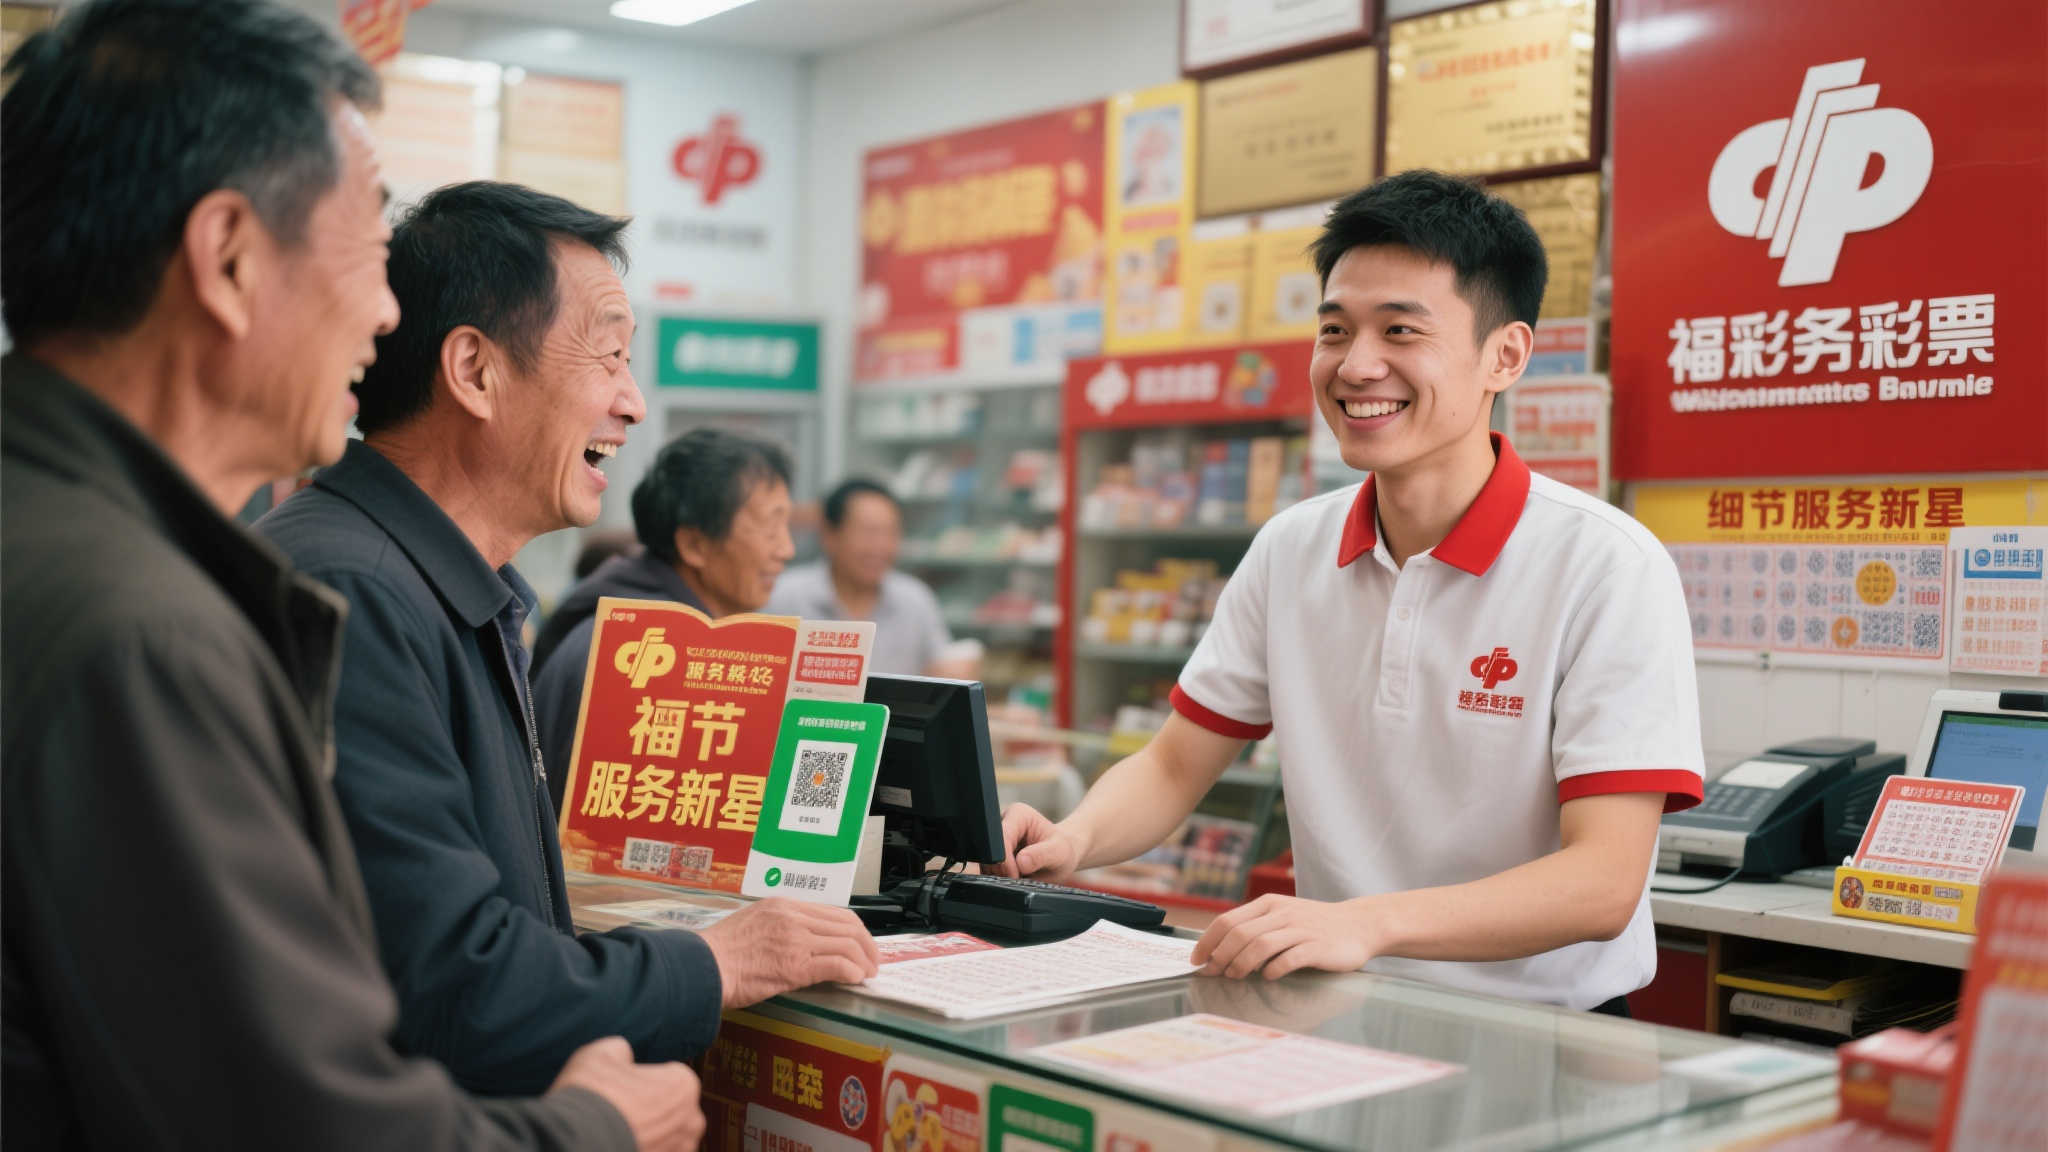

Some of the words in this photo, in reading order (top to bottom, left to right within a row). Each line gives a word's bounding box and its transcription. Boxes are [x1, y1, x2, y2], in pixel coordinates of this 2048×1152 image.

[1667, 293, 1995, 384] 福彩务彩票
[1707, 487, 1966, 530] 细节服务新星
[581, 761, 768, 833] 服务新星
